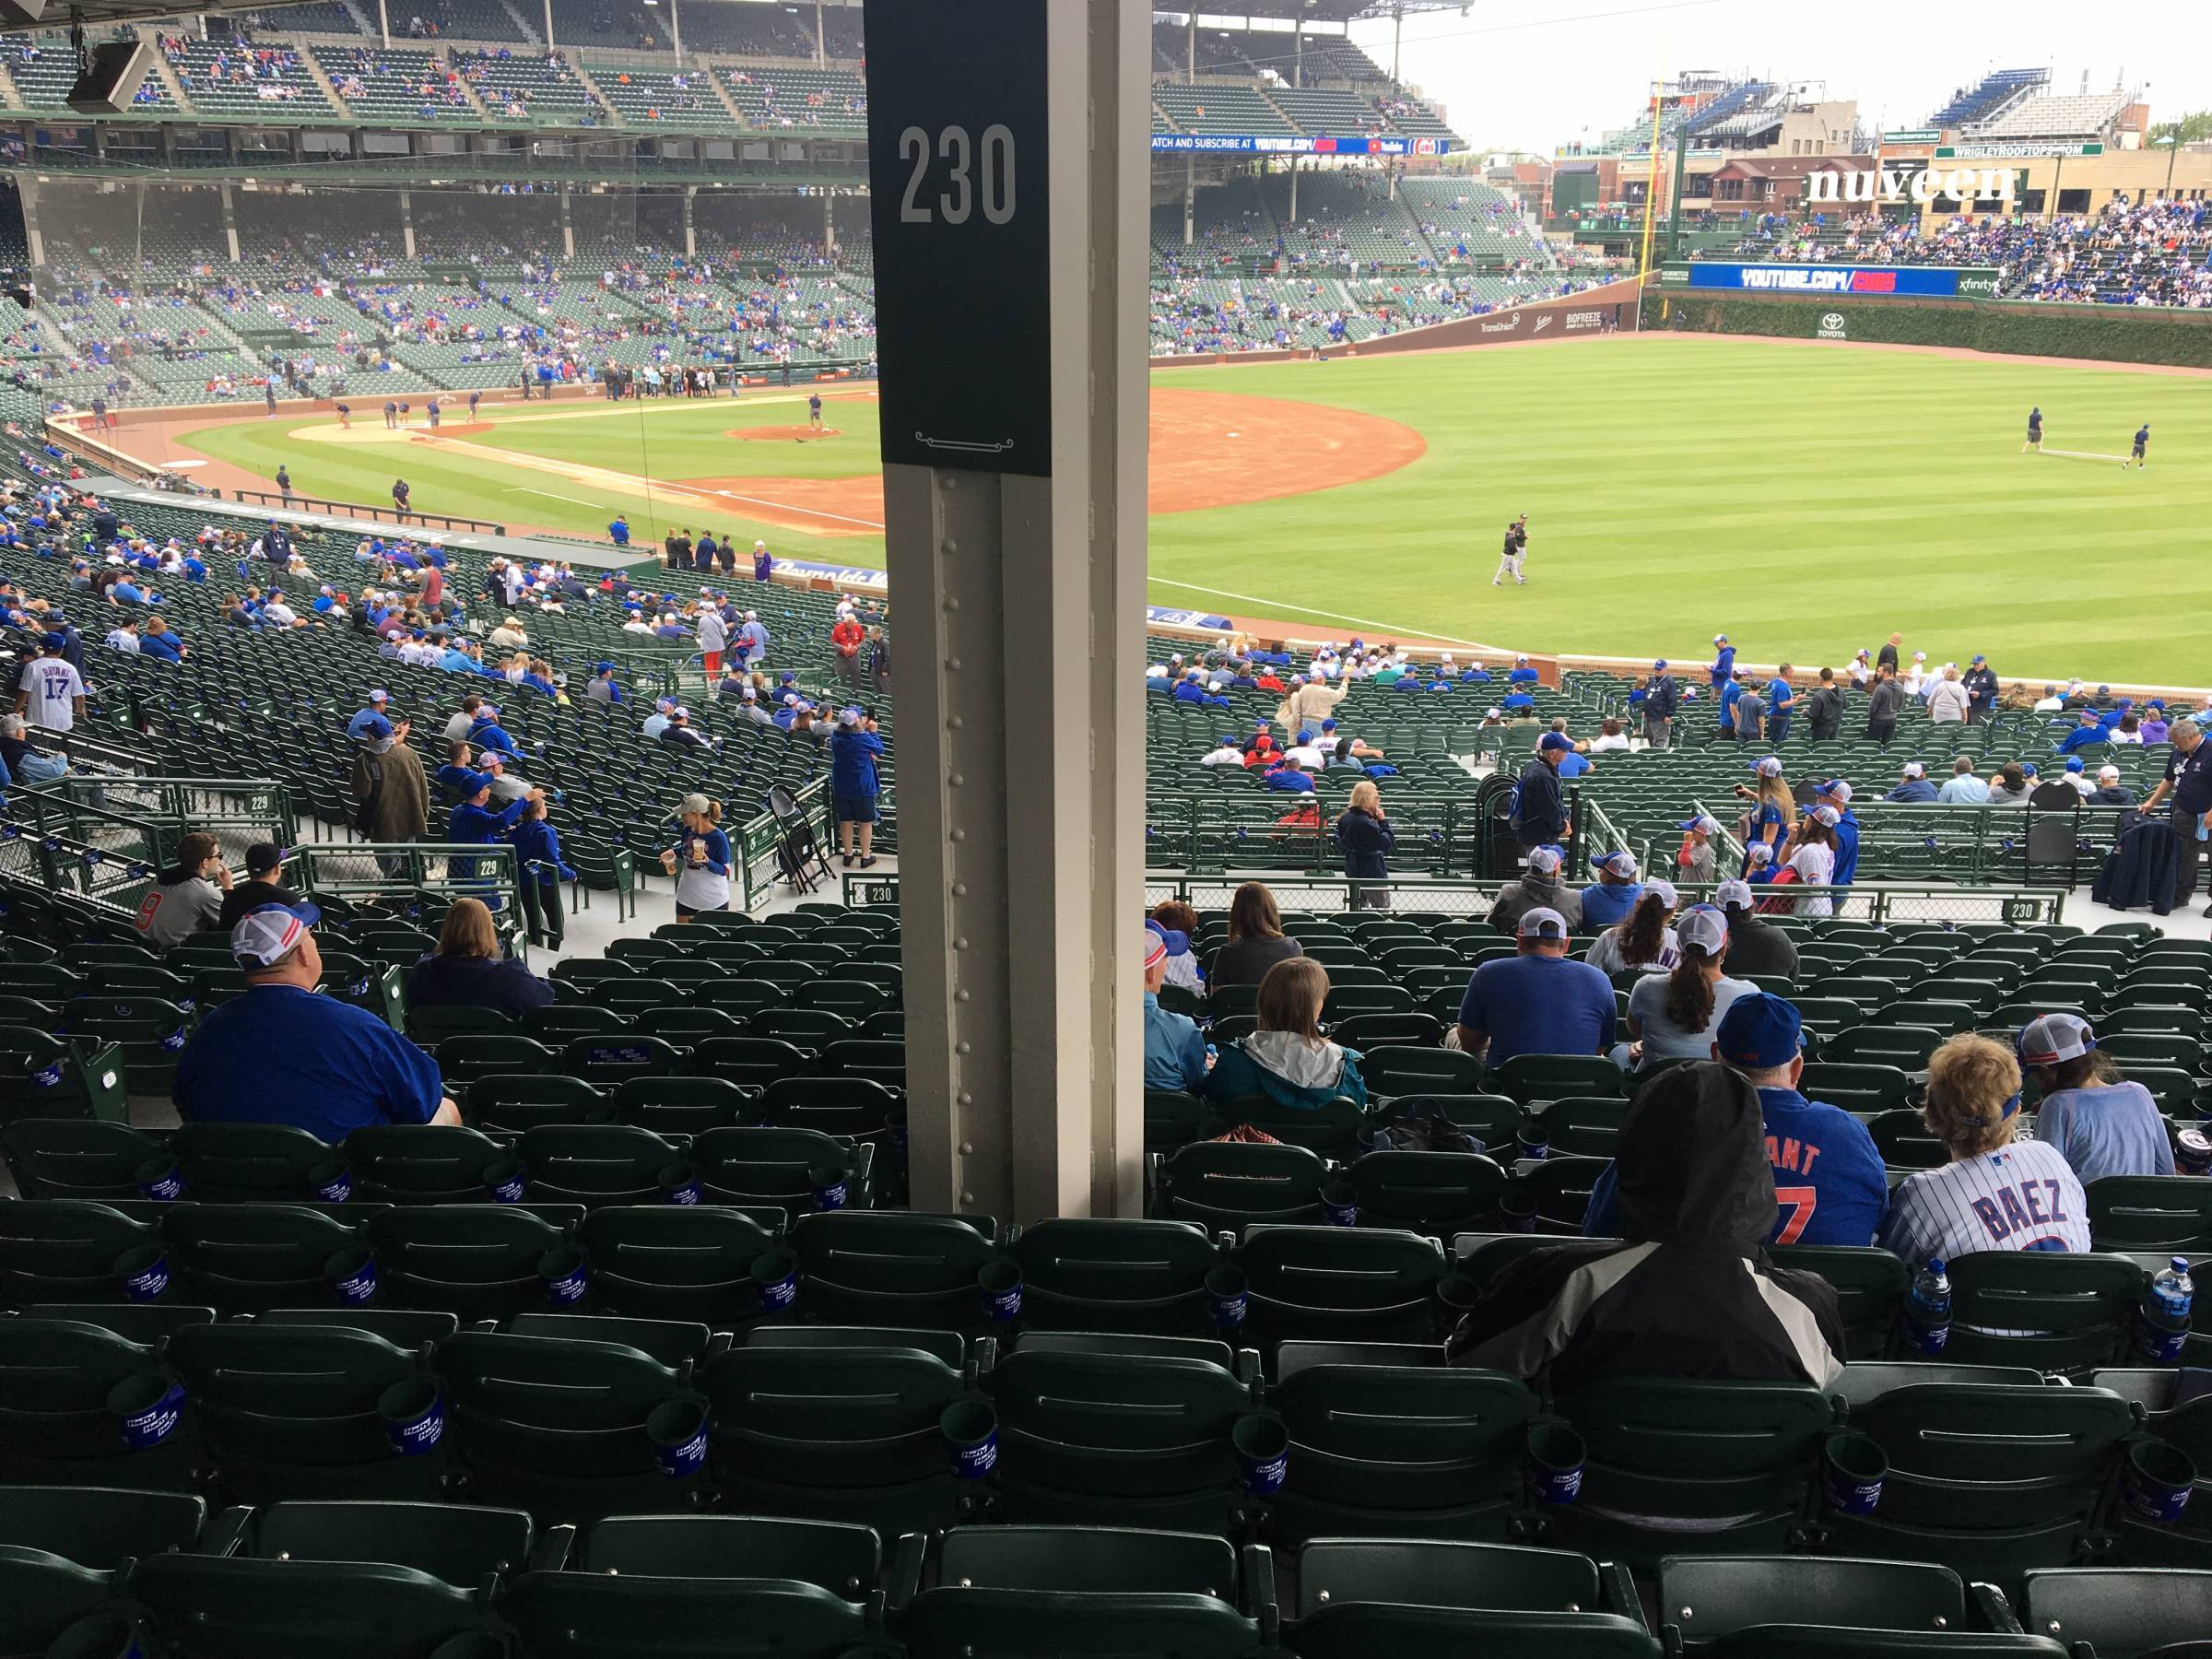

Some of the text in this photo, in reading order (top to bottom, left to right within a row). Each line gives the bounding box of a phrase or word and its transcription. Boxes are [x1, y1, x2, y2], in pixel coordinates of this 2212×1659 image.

[1175, 138, 1193, 147] AND
[1194, 139, 1240, 148] SUBSCRIBE
[1241, 139, 1252, 148] AT
[899, 124, 1017, 225] 230
[1806, 168, 2016, 202] nuveen
[1959, 277, 1994, 291] xfinity
[1567, 312, 1602, 324] BIOFREEZE
[1481, 323, 1514, 333] TransUnion
[1818, 330, 1846, 338] TOYOTA
[45, 677, 69, 700] 17
[252, 795, 268, 810] 229
[480, 860, 497, 876] 229
[872, 888, 892, 901] 230
[2011, 903, 2033, 918] 230
[1971, 1179, 2068, 1242] BAEZ
[404, 1416, 430, 1436] Hefty
